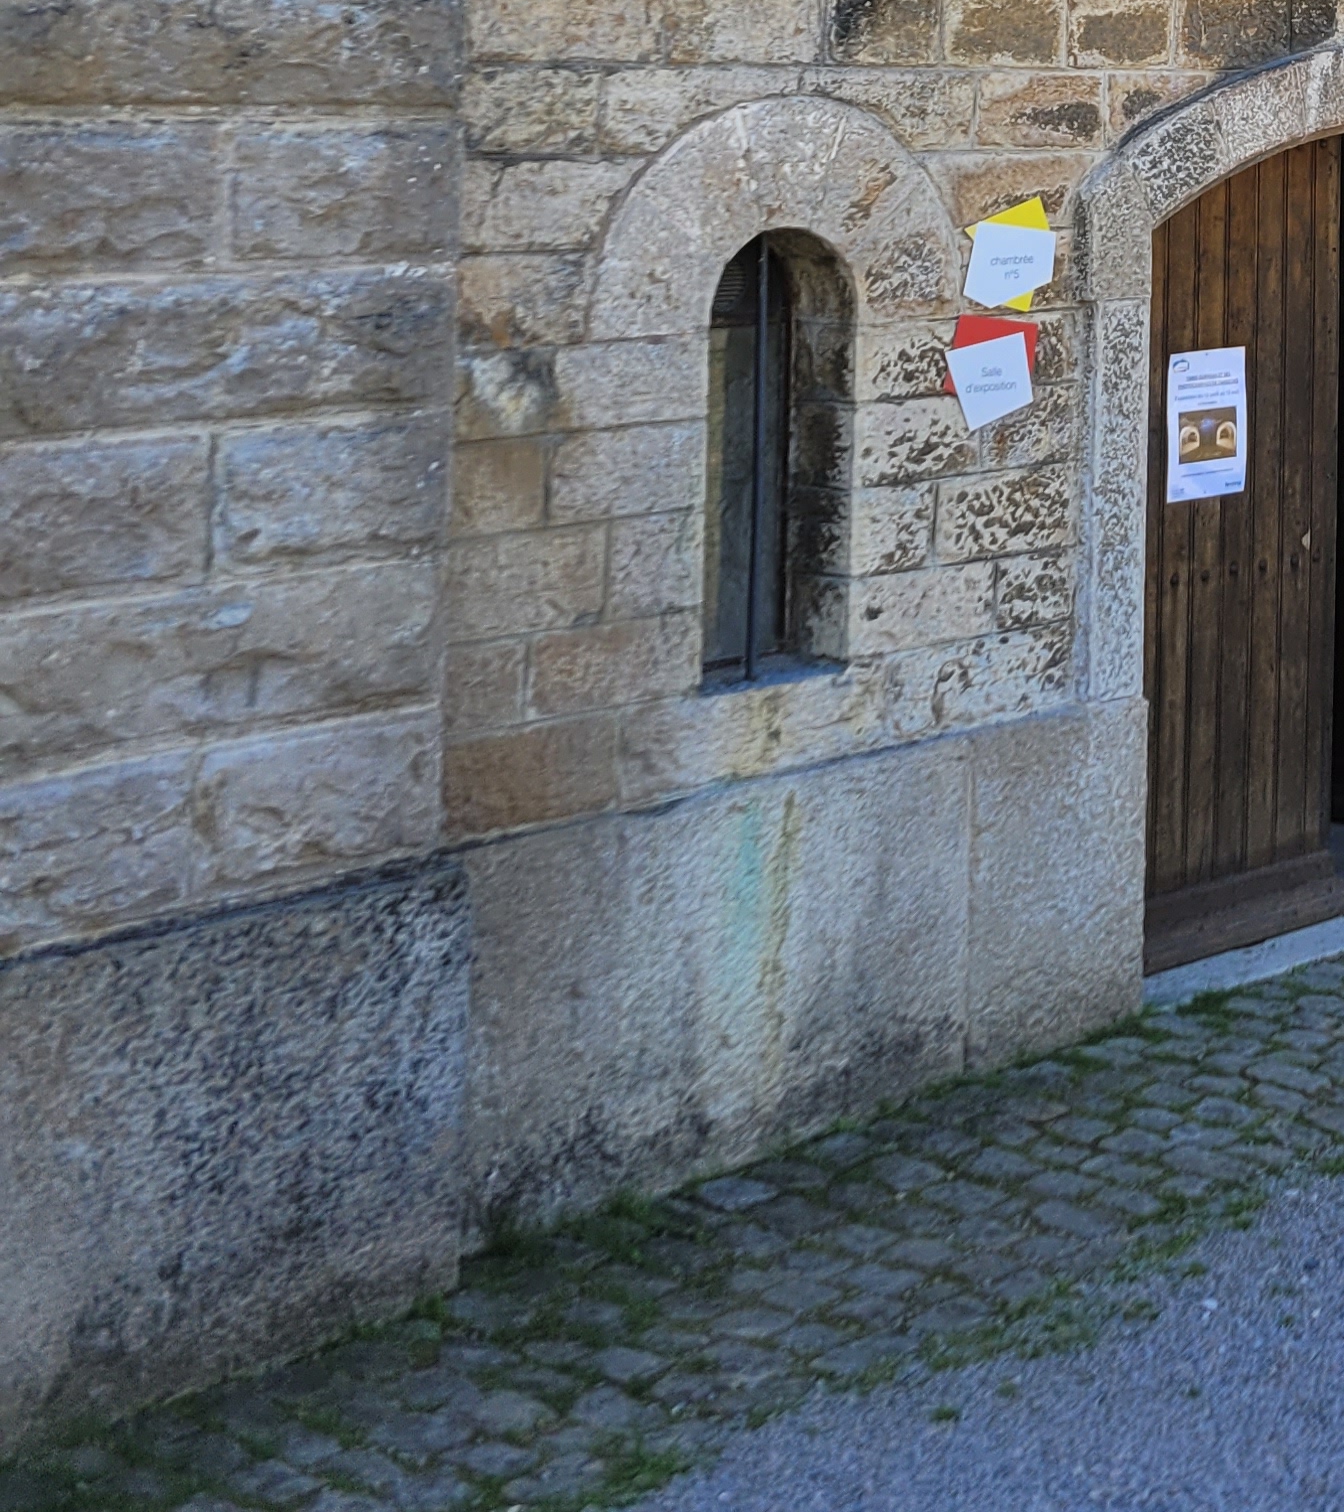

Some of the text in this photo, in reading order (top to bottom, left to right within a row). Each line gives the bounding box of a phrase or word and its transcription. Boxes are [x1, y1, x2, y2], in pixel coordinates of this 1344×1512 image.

[990, 255, 1034, 266] chambrée
[981, 367, 1003, 377] Salle
[965, 381, 1017, 395] d'exposition
